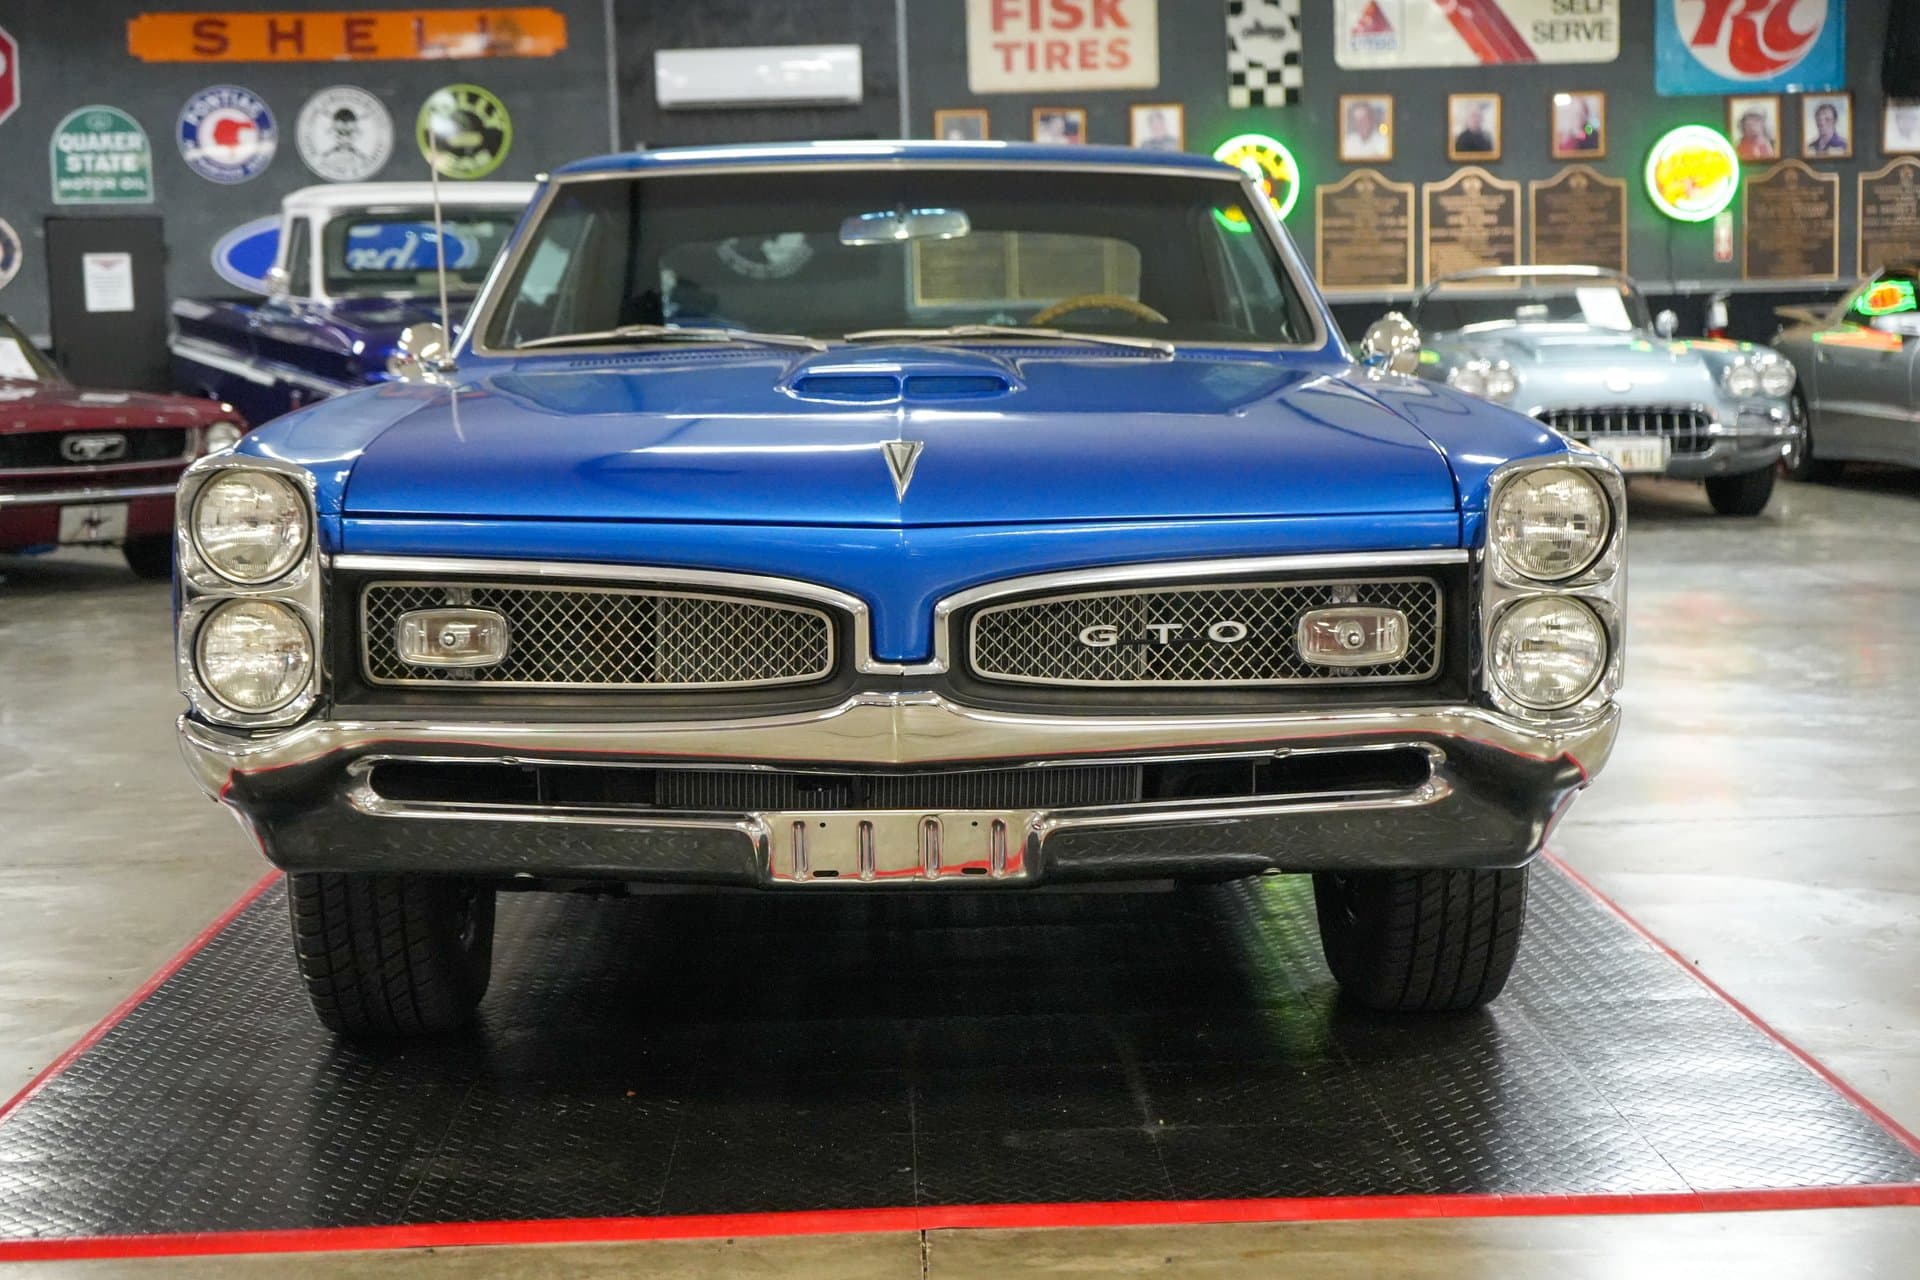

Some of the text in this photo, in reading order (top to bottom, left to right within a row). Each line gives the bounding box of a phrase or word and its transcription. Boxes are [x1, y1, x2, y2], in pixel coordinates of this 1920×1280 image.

[991, 0, 1130, 32] FISK
[192, 15, 510, 56] SHELL
[1532, 19, 1614, 43] SERVE
[1691, 0, 1821, 75] RC
[993, 37, 1131, 73] TIRES
[425, 91, 506, 131] LLY
[58, 132, 143, 152] QUAKER
[65, 153, 139, 173] STATE
[119, 177, 146, 190] OIL
[1078, 620, 1248, 647] GTO
